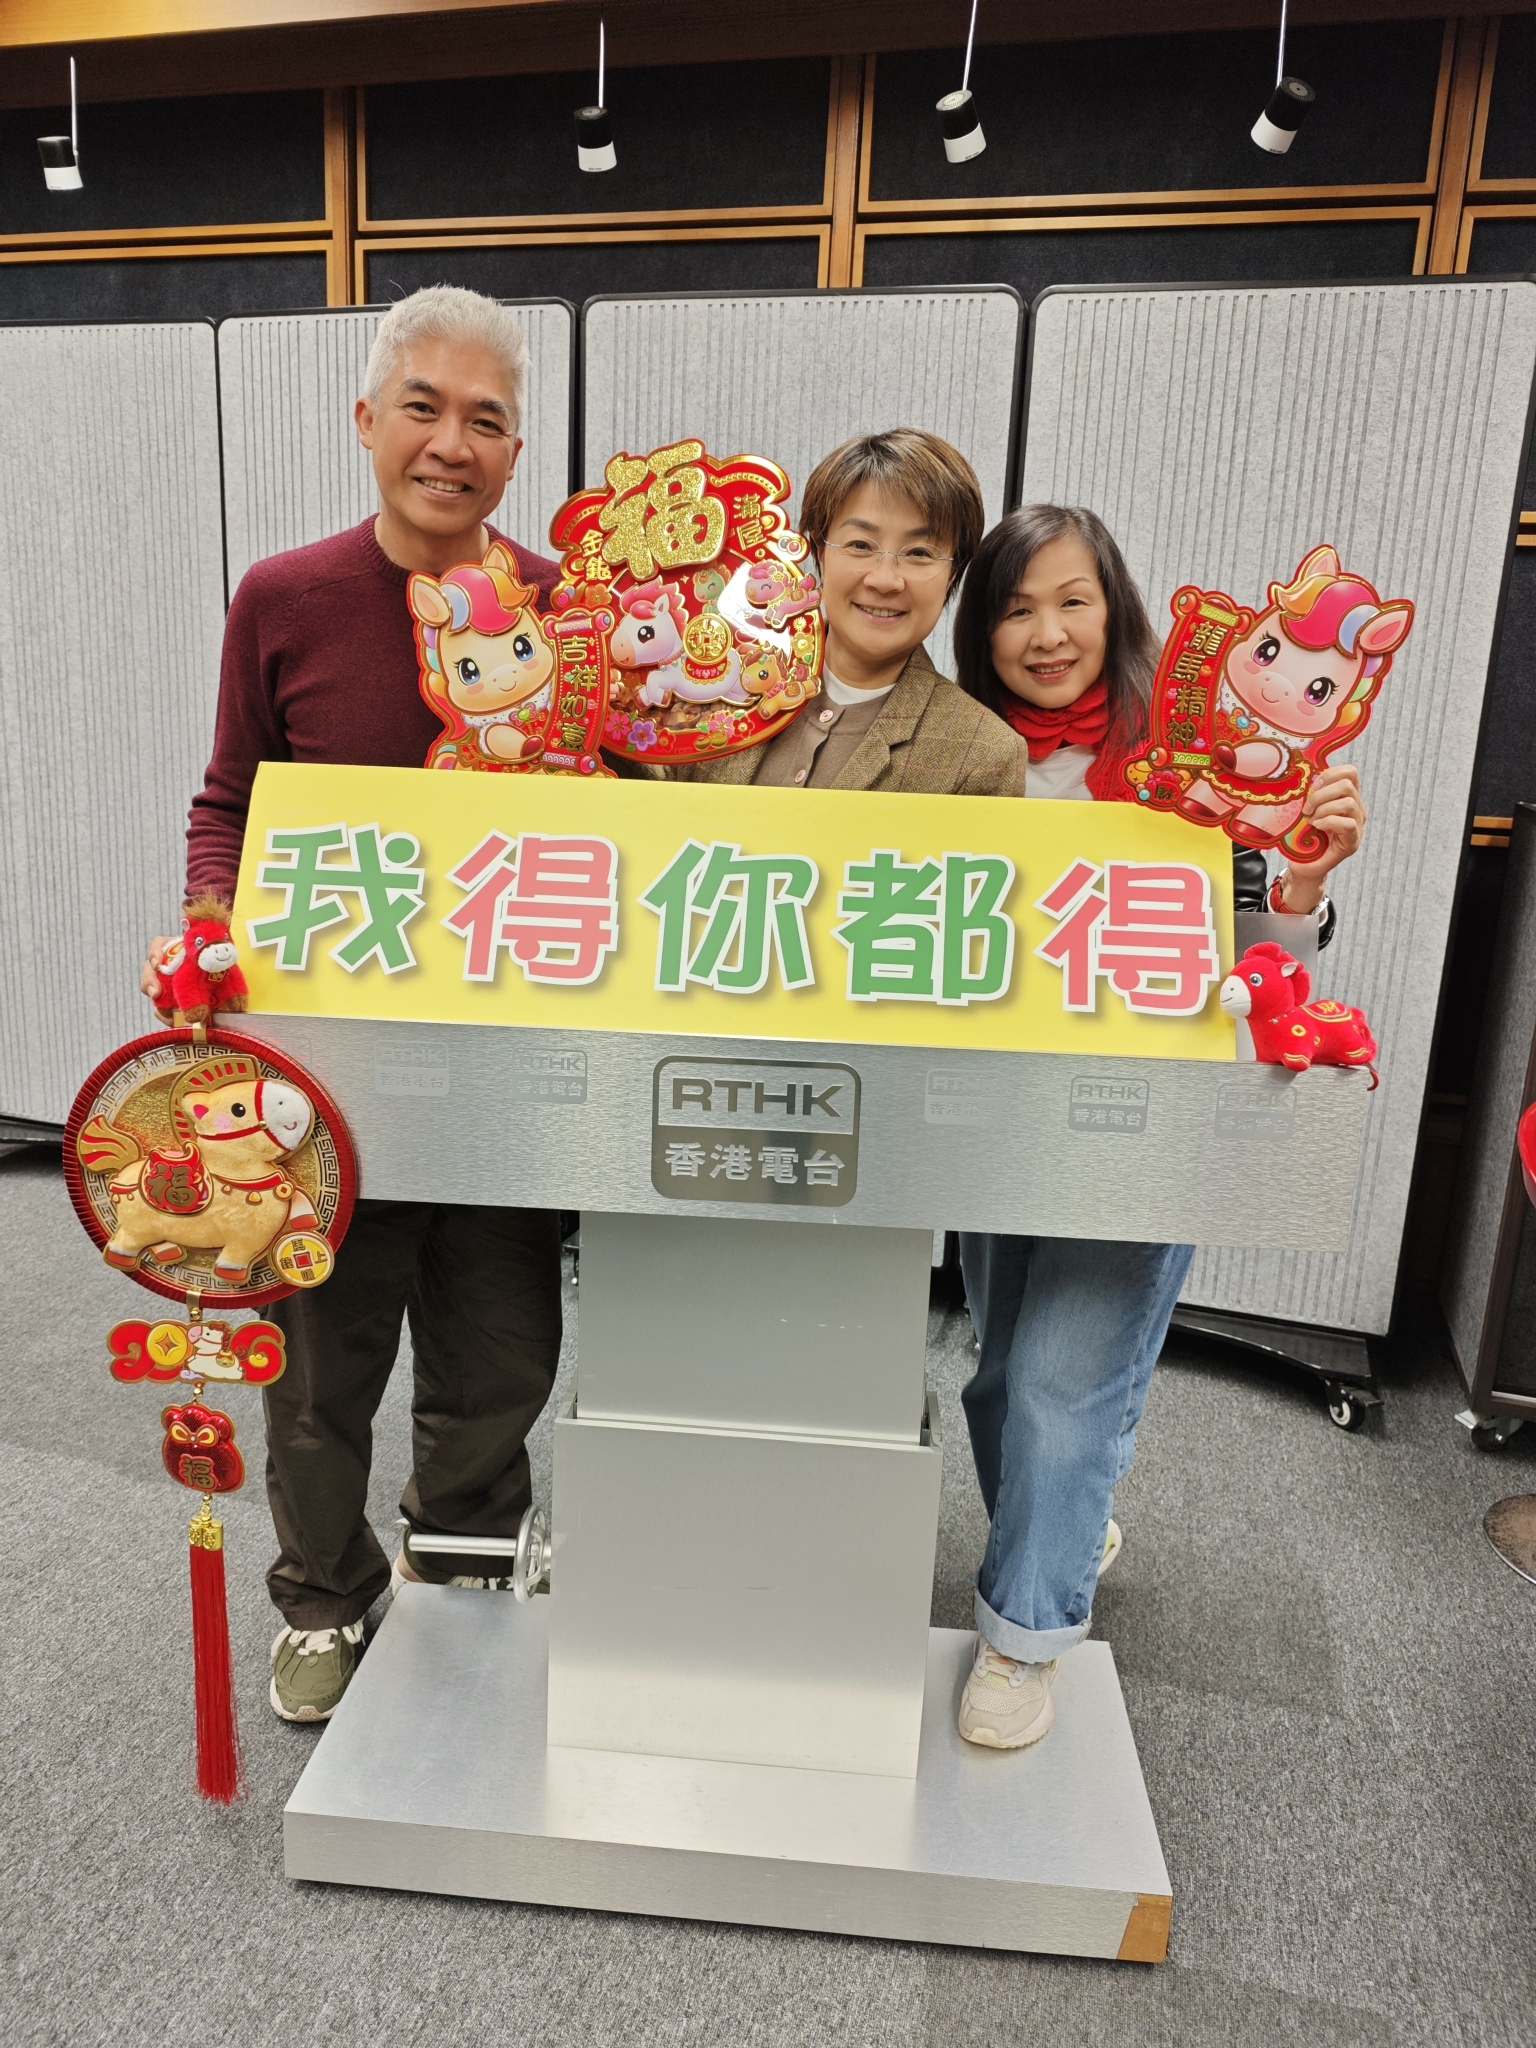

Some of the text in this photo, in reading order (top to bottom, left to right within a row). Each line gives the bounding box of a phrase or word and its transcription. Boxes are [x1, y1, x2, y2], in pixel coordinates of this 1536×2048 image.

[599, 440, 726, 579] 福
[733, 493, 767, 551] 滿屋
[560, 634, 598, 752] 吉祥如意
[1168, 620, 1228, 750] 龍馬精神
[247, 821, 1220, 1017] 我得你都得
[672, 1077, 846, 1118] RTHK
[1076, 1082, 1143, 1099] RTHK
[1073, 1108, 1143, 1128] 香港電台
[149, 1163, 198, 1207] 福
[664, 1142, 846, 1187] 香港電台
[182, 1456, 217, 1491] 福
